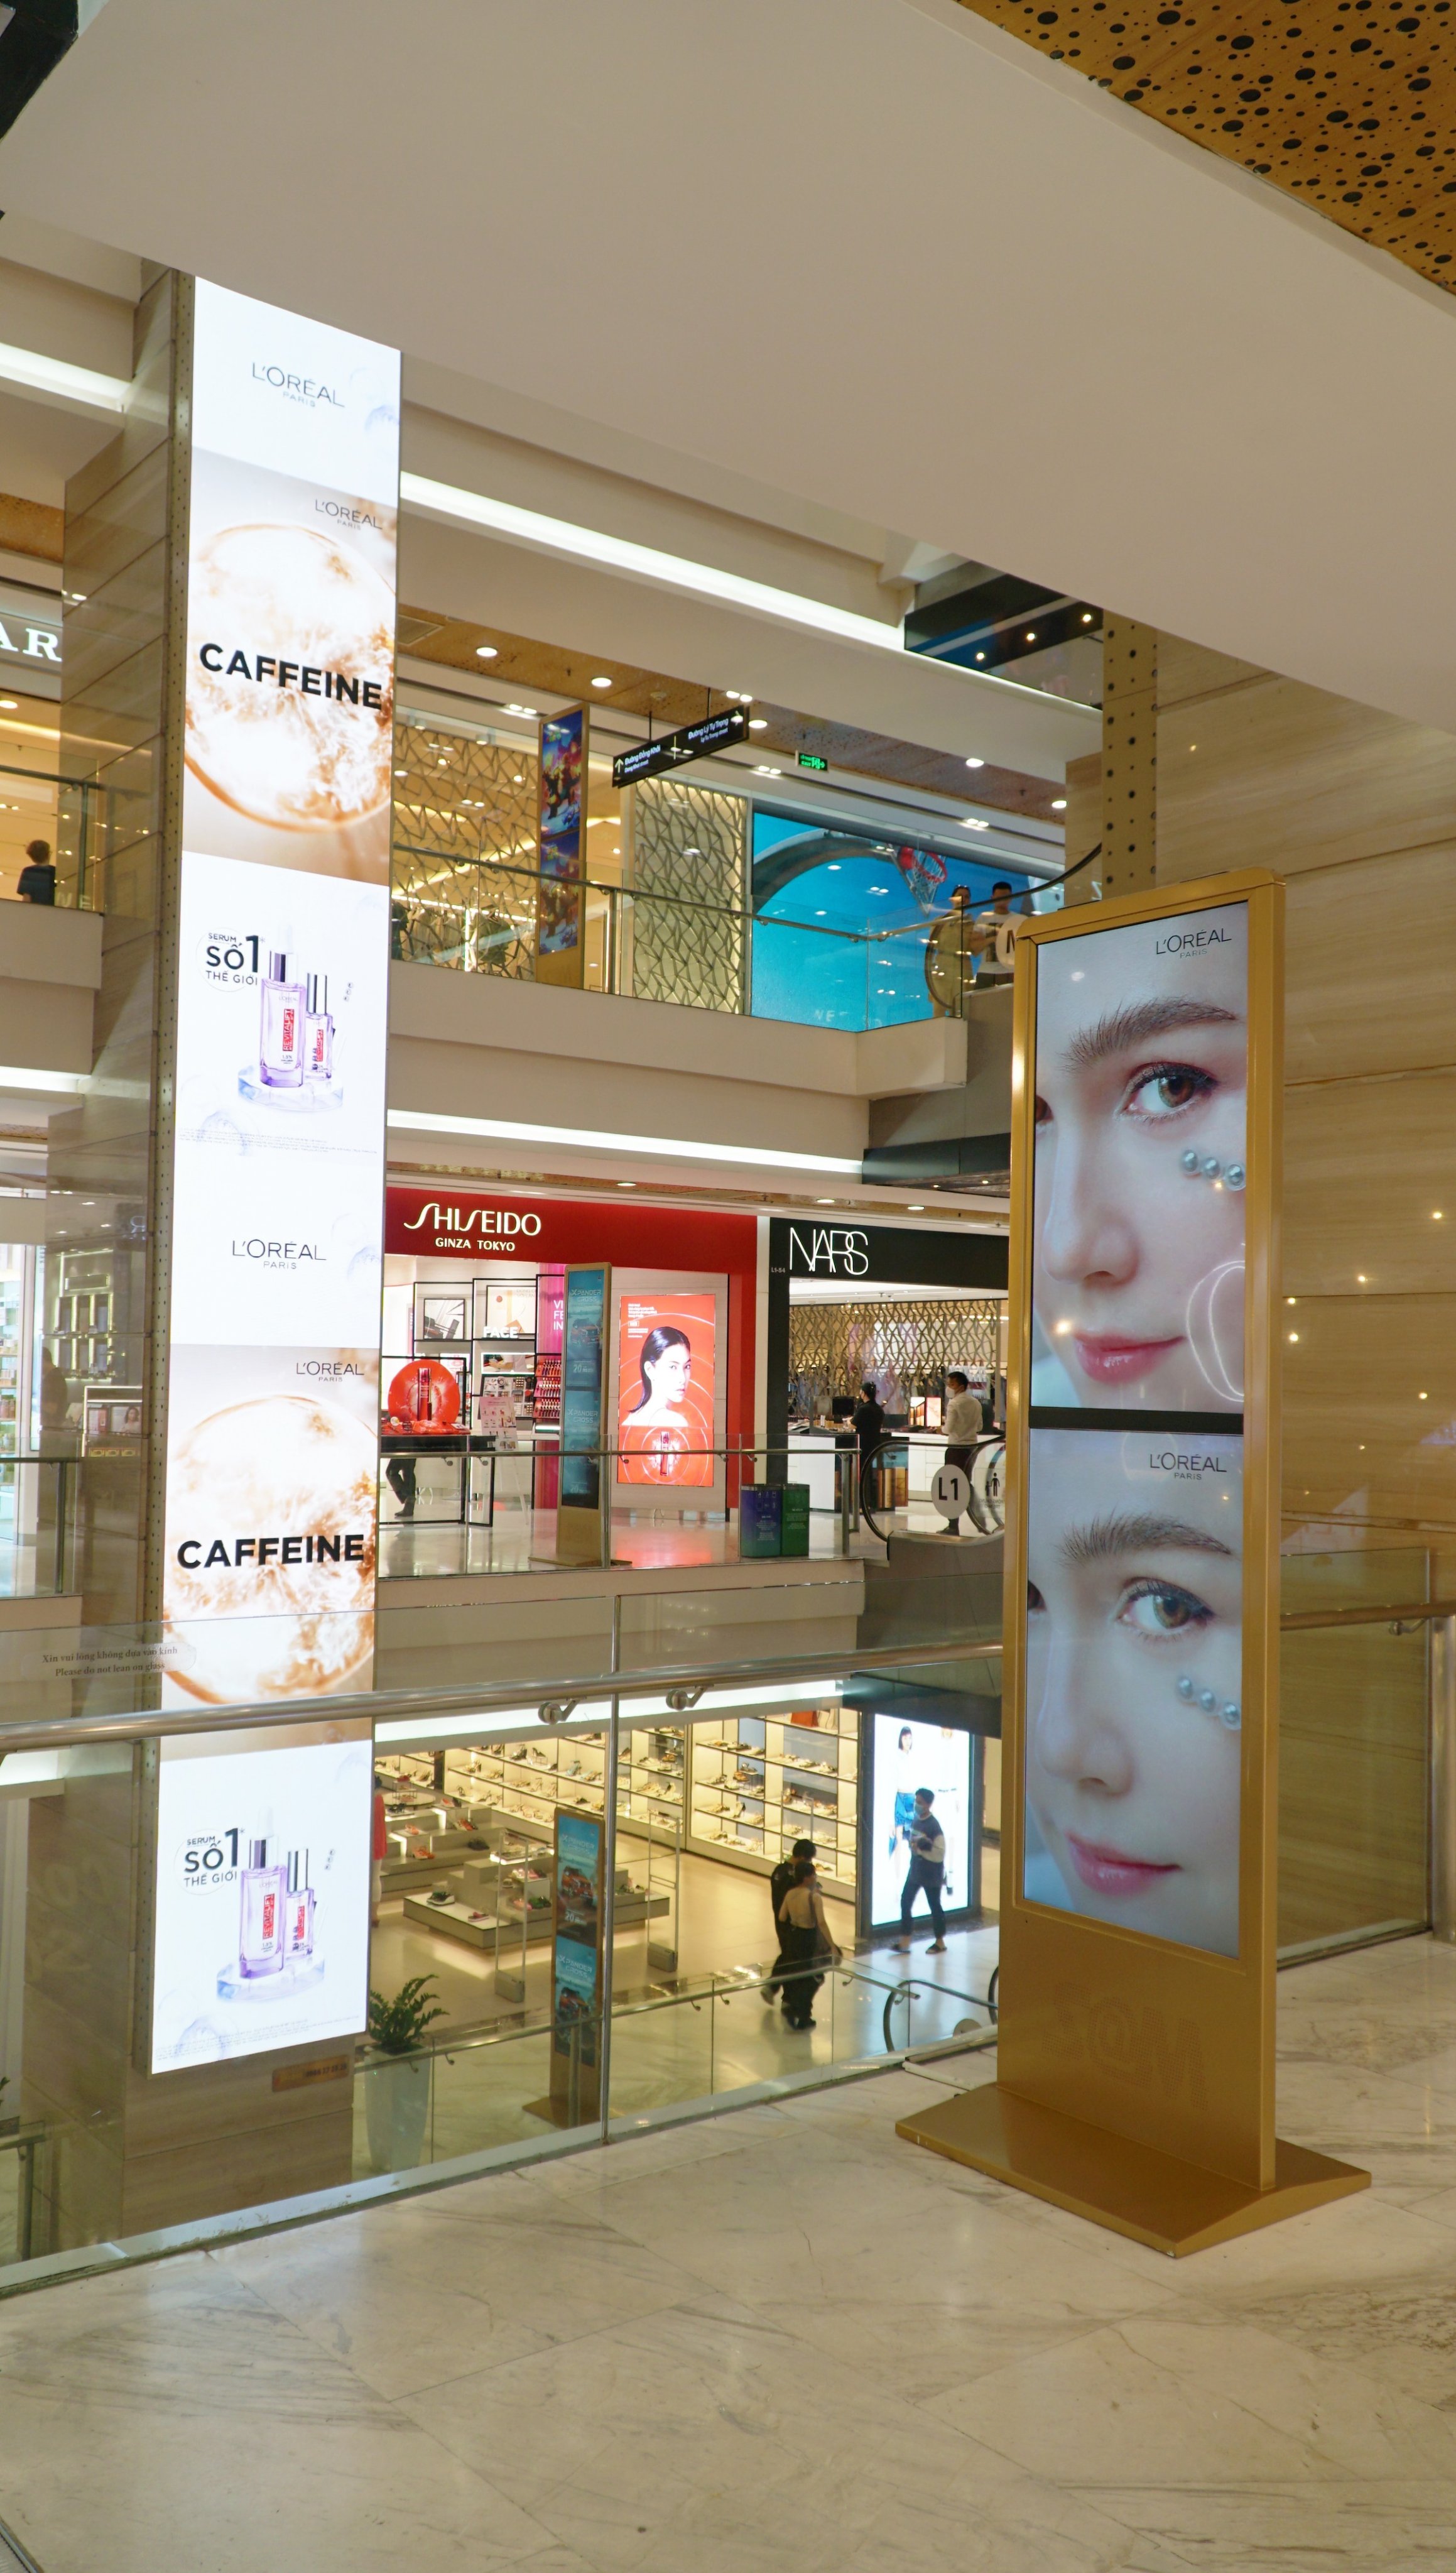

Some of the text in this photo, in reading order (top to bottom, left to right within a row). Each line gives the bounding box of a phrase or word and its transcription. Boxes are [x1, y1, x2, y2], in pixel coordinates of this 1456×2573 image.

[253, 362, 345, 407] L'ORÉAL
[283, 390, 316, 407] PARIS
[315, 499, 383, 530] L'ORÉAL
[337, 518, 361, 530] PARIS
[200, 643, 382, 710] CAFFEINE
[209, 932, 236, 942] SERUM
[1156, 928, 1232, 954] L'ORÉAL
[206, 942, 244, 970] SỐ
[1180, 948, 1207, 959] PARIS
[205, 970, 258, 986] THẾ GIỚI
[403, 1203, 541, 1236] SHISEIDO
[232, 1239, 327, 1260] L'ORÉAL
[435, 1237, 515, 1252] GINZA TOKYO
[790, 1227, 869, 1276] NARS
[263, 1260, 297, 1269] PARIS
[483, 1326, 518, 1338] FACE
[296, 1361, 364, 1375] L'ORÉAL
[1150, 1453, 1227, 1472] L'ORÉAL
[1174, 1472, 1202, 1480] PARIS
[938, 1477, 958, 1501] L1
[177, 1534, 364, 1569] CAFFEINE
[42, 1654, 58, 1663] Xin
[55, 1668, 82, 1677] Please
[84, 1666, 94, 1675] do
[113, 1664, 131, 1672] lean
[145, 1662, 165, 1672] glass
[187, 1835, 215, 1845] SERUM
[184, 1840, 224, 1873] SỐ
[183, 1869, 237, 1887] THẾ GIỚI
